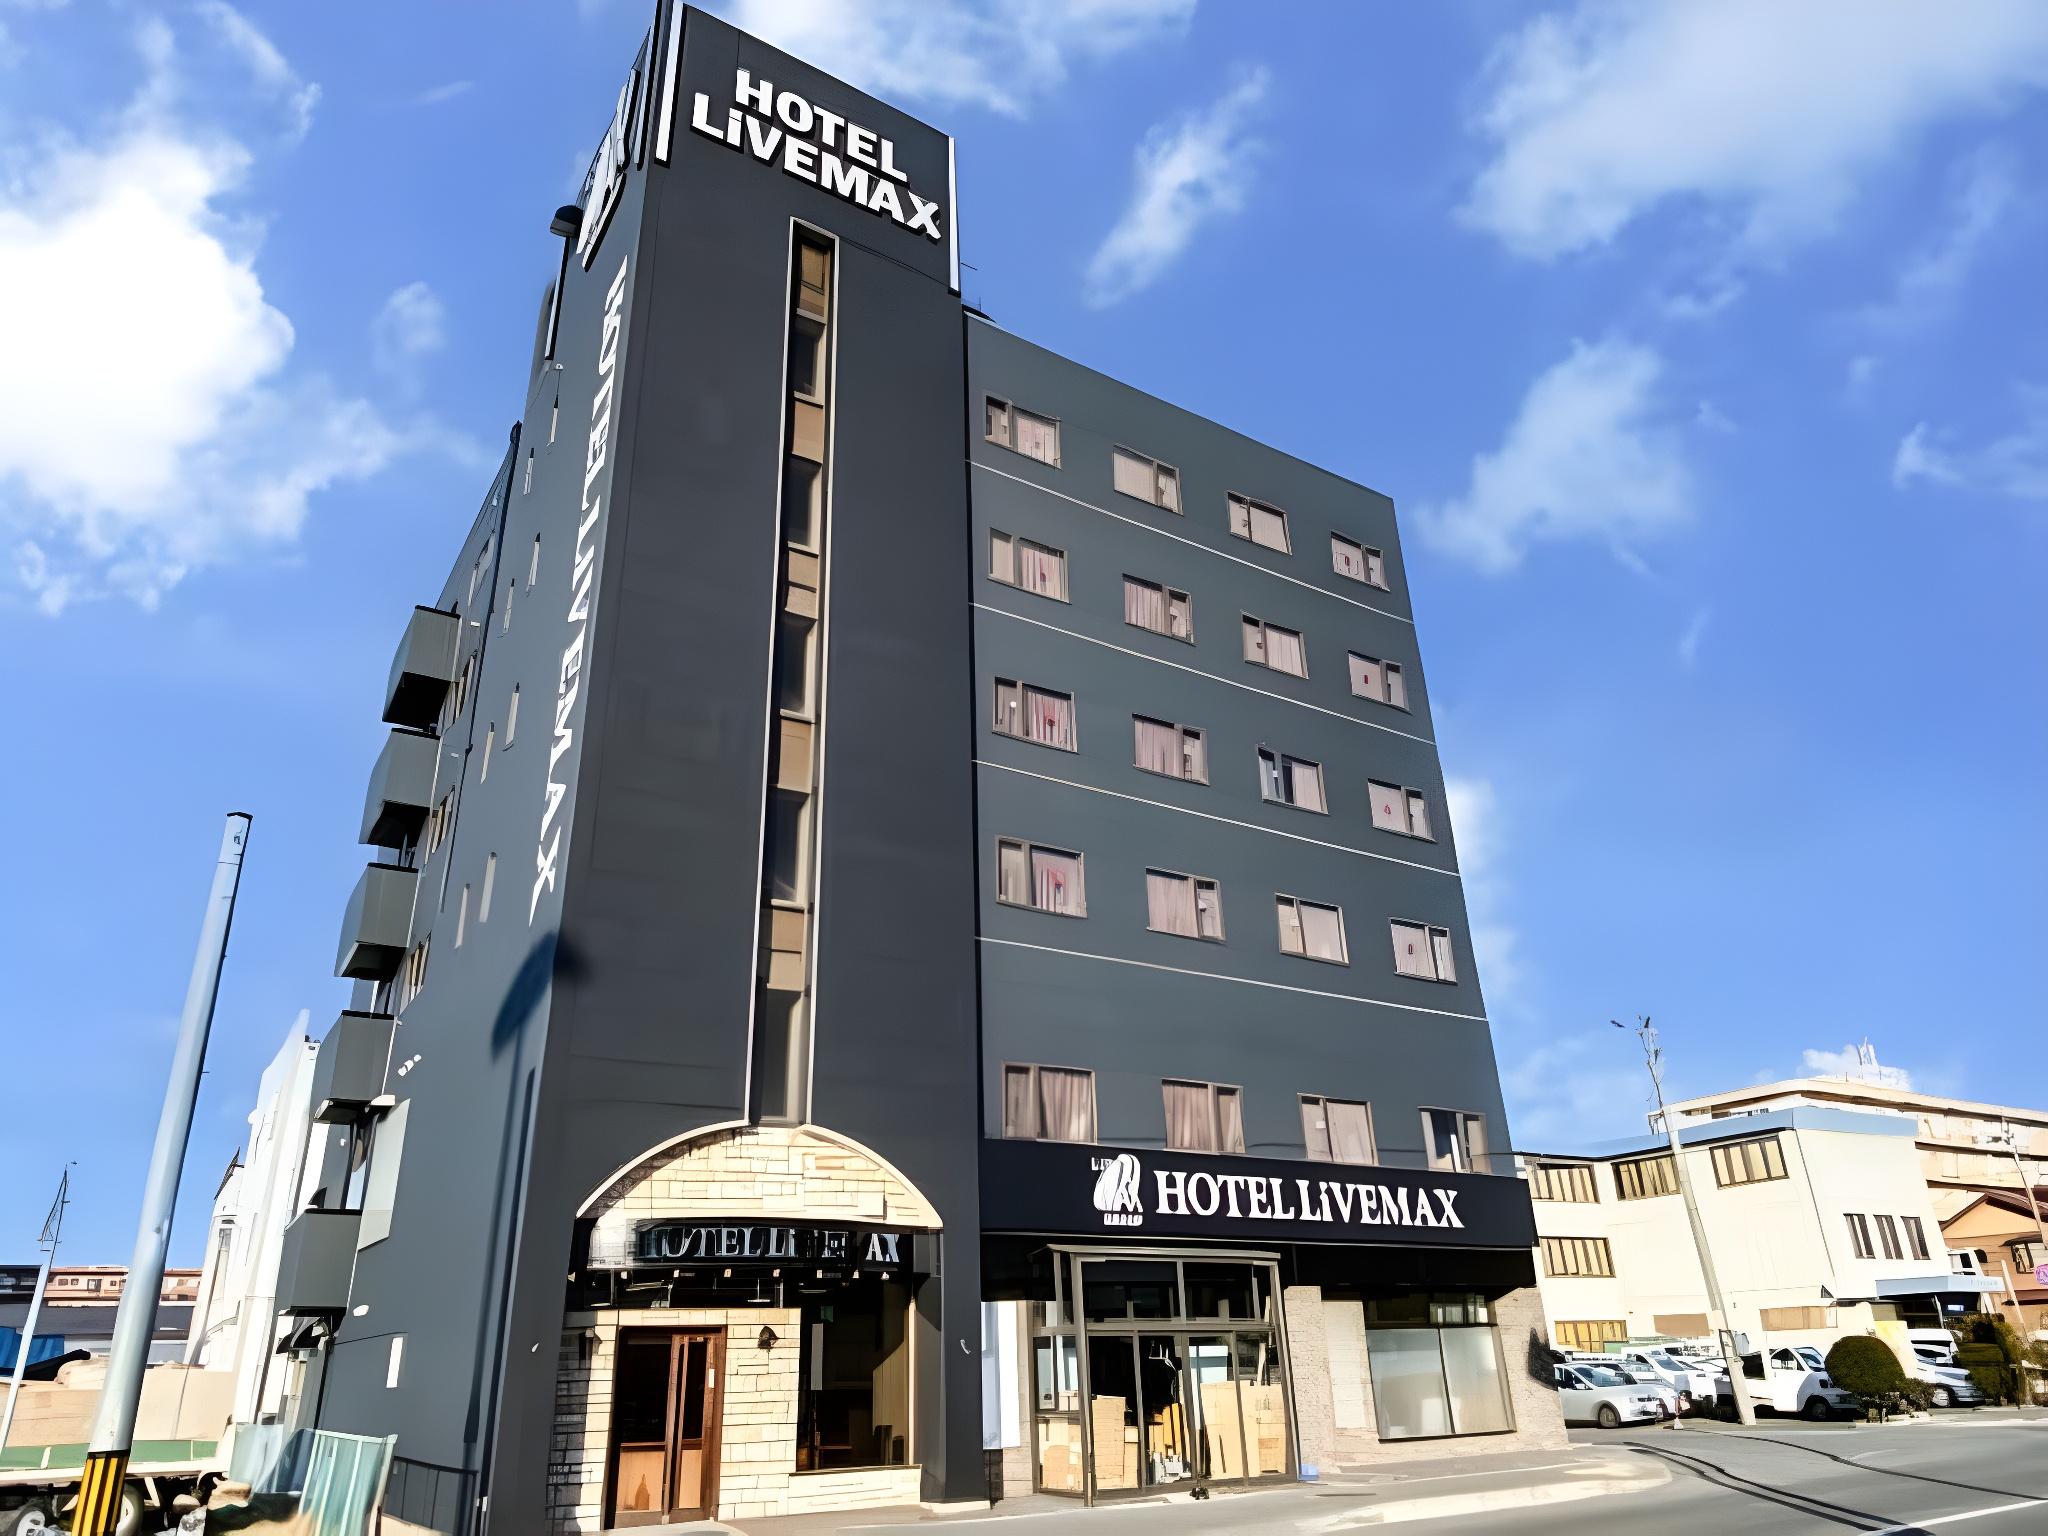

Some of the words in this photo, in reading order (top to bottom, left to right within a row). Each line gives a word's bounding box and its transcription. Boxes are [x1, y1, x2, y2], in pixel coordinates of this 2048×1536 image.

[691, 91, 943, 241] LiVEMAX
[735, 67, 908, 183] HOTEL
[1153, 1169, 1295, 1220] HOTEL
[1295, 1178, 1466, 1229] LiVEMAX
